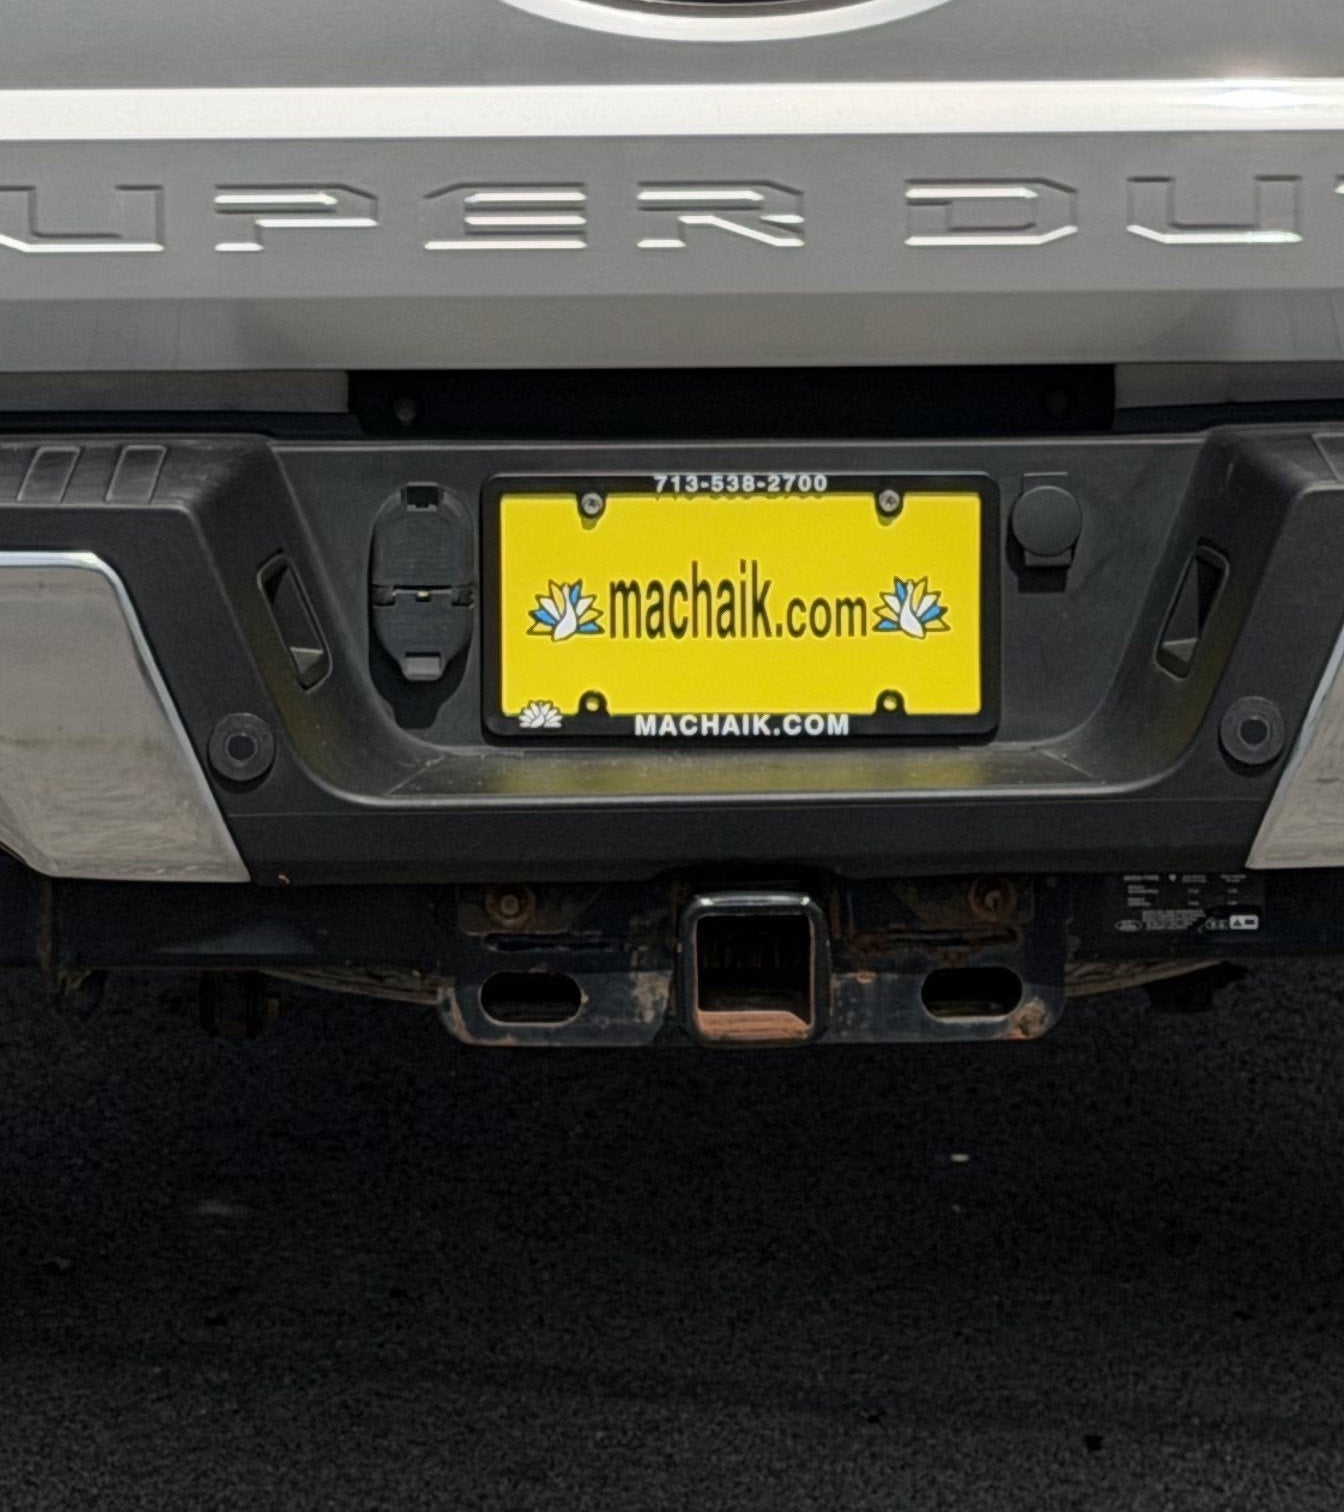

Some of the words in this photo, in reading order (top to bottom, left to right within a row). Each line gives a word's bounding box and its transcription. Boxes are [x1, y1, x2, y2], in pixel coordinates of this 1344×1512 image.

[652, 474, 828, 493] 713-538-2700
[608, 559, 868, 639] machaik.com
[634, 714, 850, 737] MACHAIK.COM
